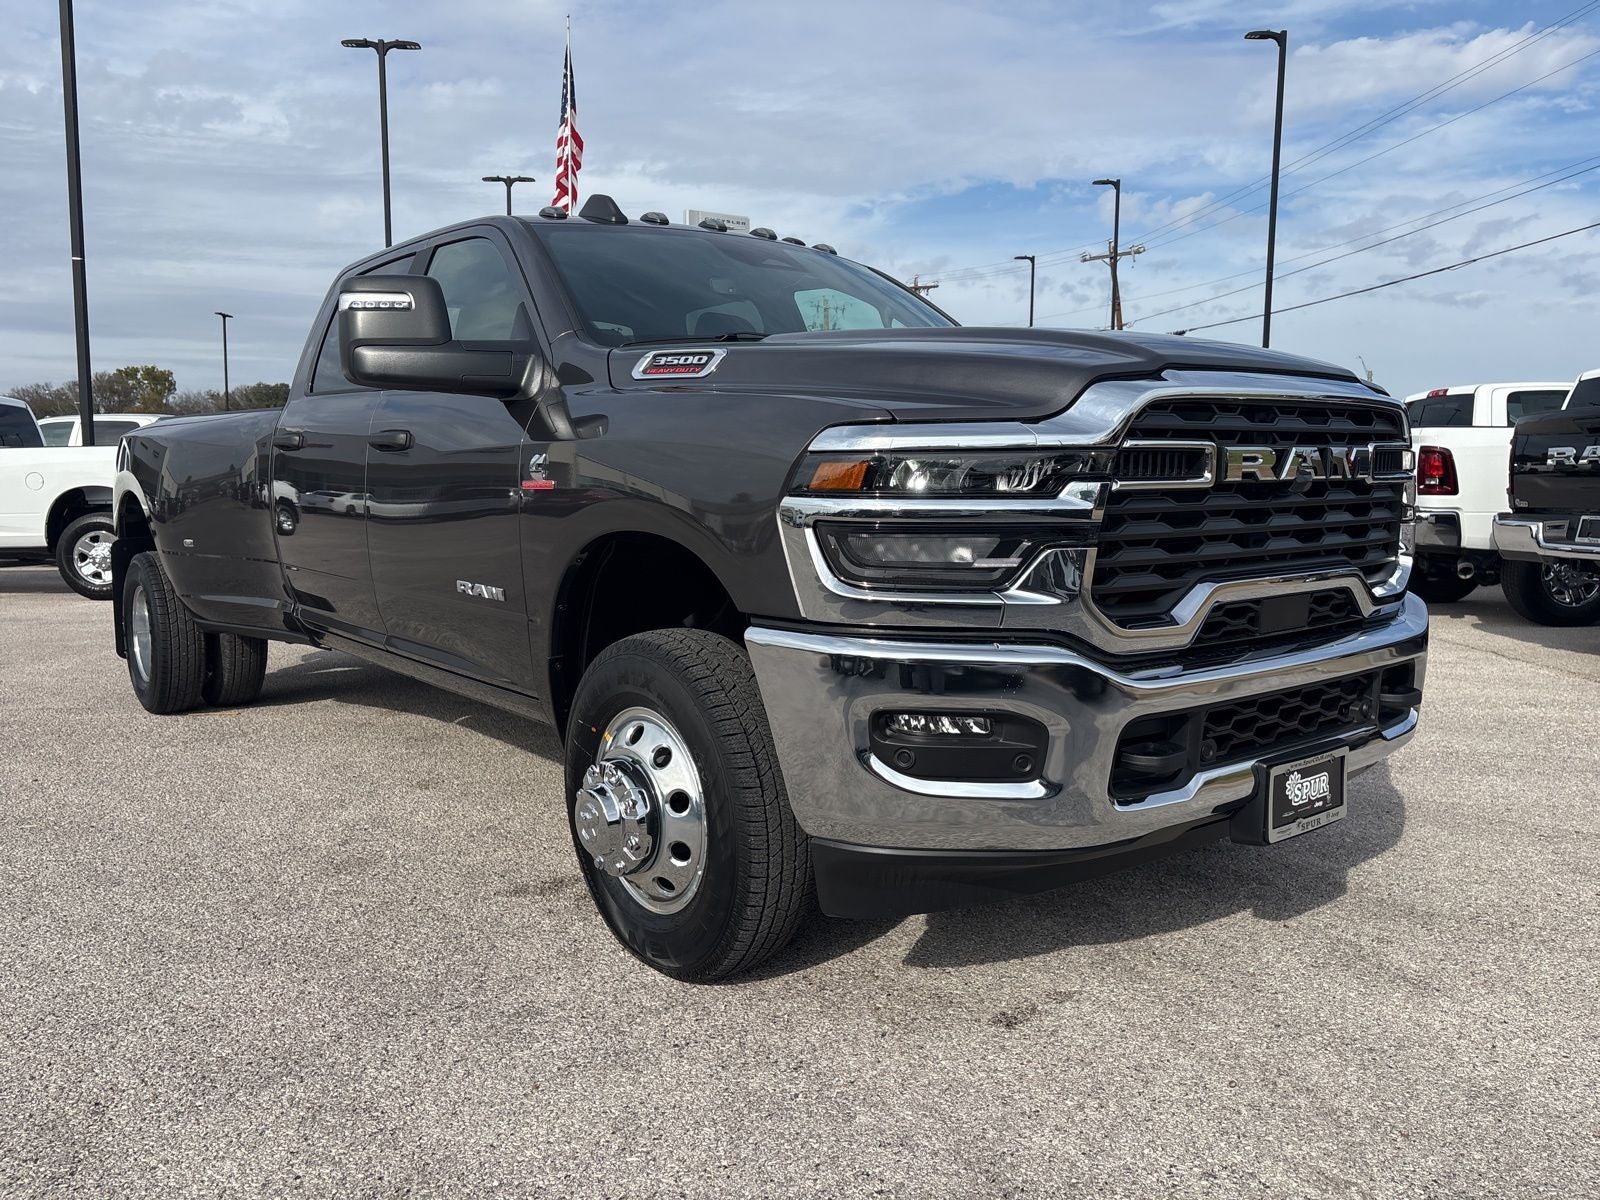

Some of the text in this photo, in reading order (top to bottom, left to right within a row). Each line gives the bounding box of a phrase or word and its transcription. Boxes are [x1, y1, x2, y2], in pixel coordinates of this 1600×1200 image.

[653, 355, 708, 365] 3500
[1223, 446, 1370, 481] RAM
[456, 579, 506, 602] RAM
[1293, 774, 1329, 802] SPUR
[1300, 817, 1322, 831] SPUR
